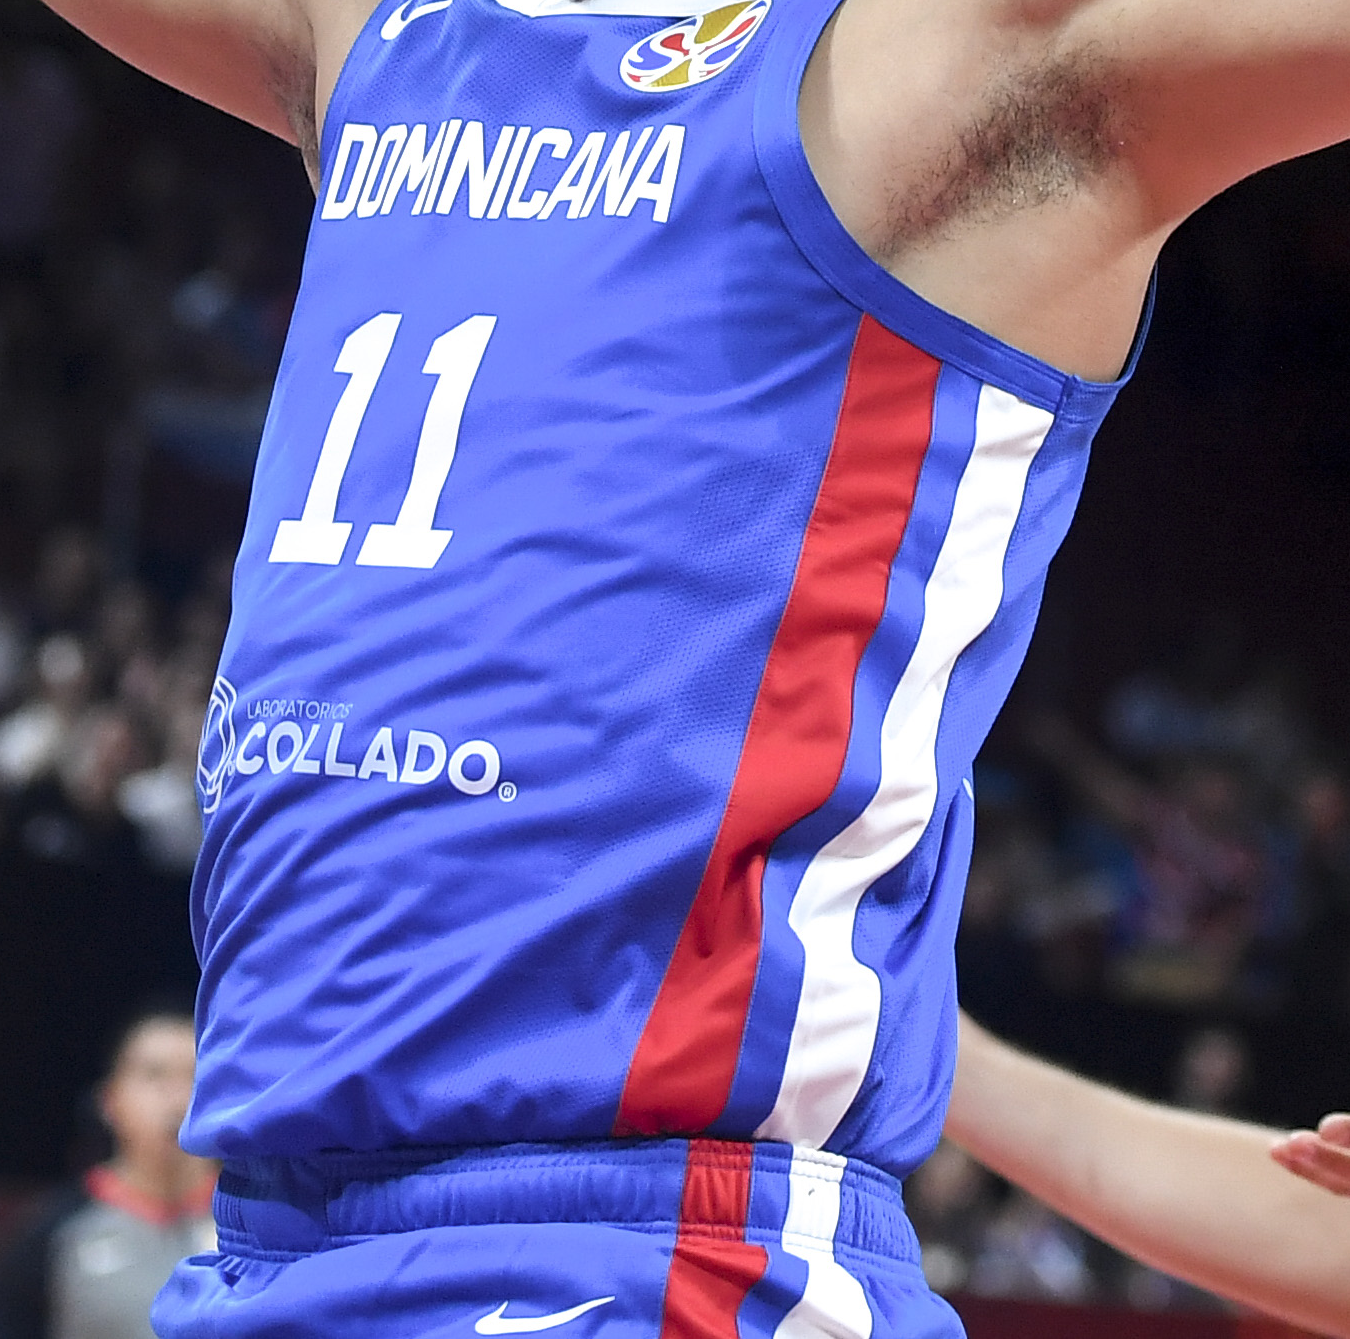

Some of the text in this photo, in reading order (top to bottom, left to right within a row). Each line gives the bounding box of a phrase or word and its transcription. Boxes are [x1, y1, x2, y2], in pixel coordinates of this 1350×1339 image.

[320, 118, 687, 223] DOMINICANA
[267, 311, 498, 569] 11
[247, 698, 354, 720] LABORATORIOS
